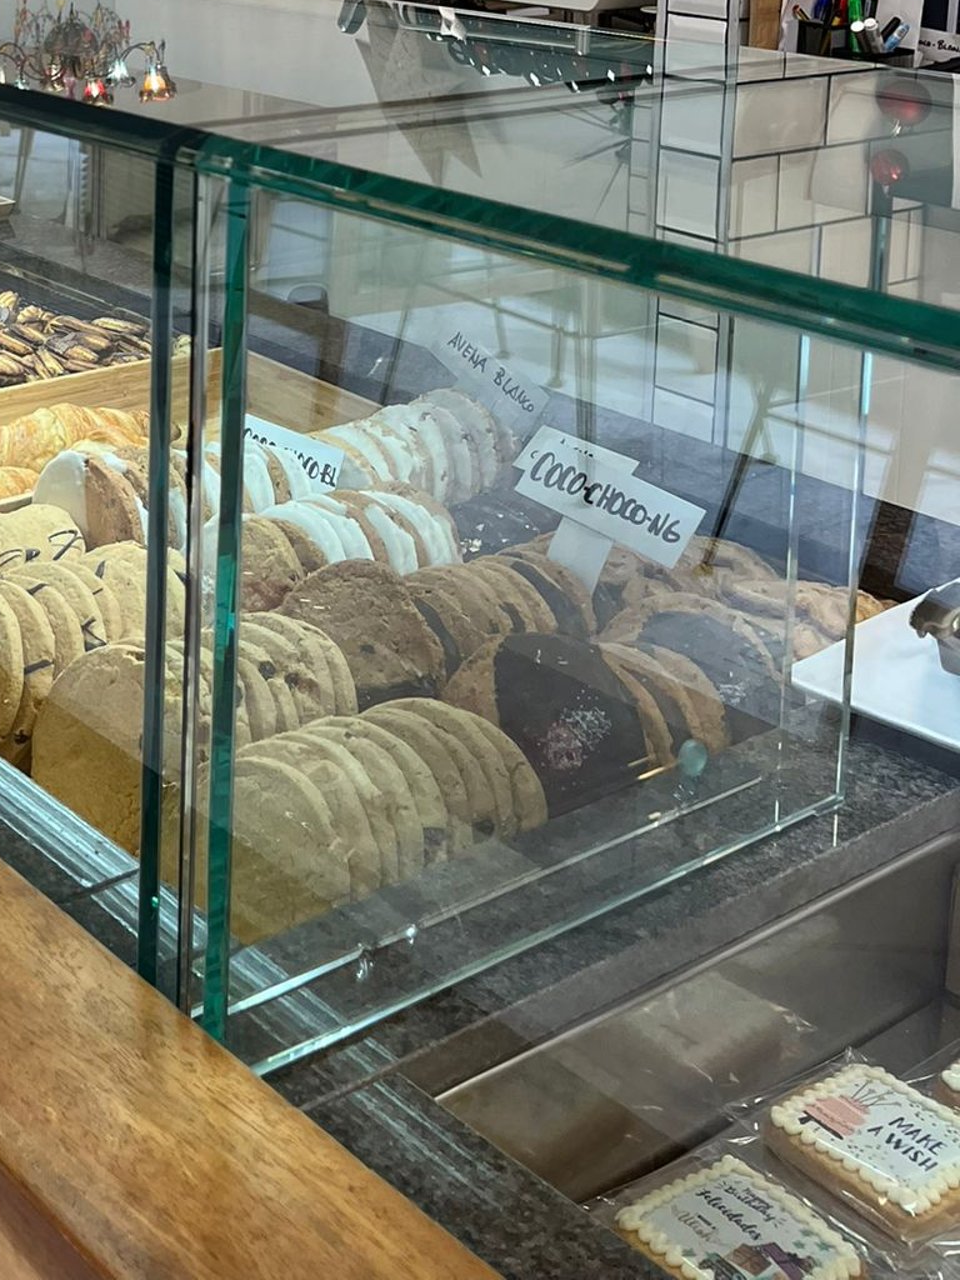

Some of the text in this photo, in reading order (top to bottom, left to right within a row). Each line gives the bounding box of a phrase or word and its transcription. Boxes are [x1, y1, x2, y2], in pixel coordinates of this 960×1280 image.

[447, 331, 488, 373] AVENA
[867, 1125, 939, 1172] A WISH
[888, 1116, 948, 1156] MAKE
